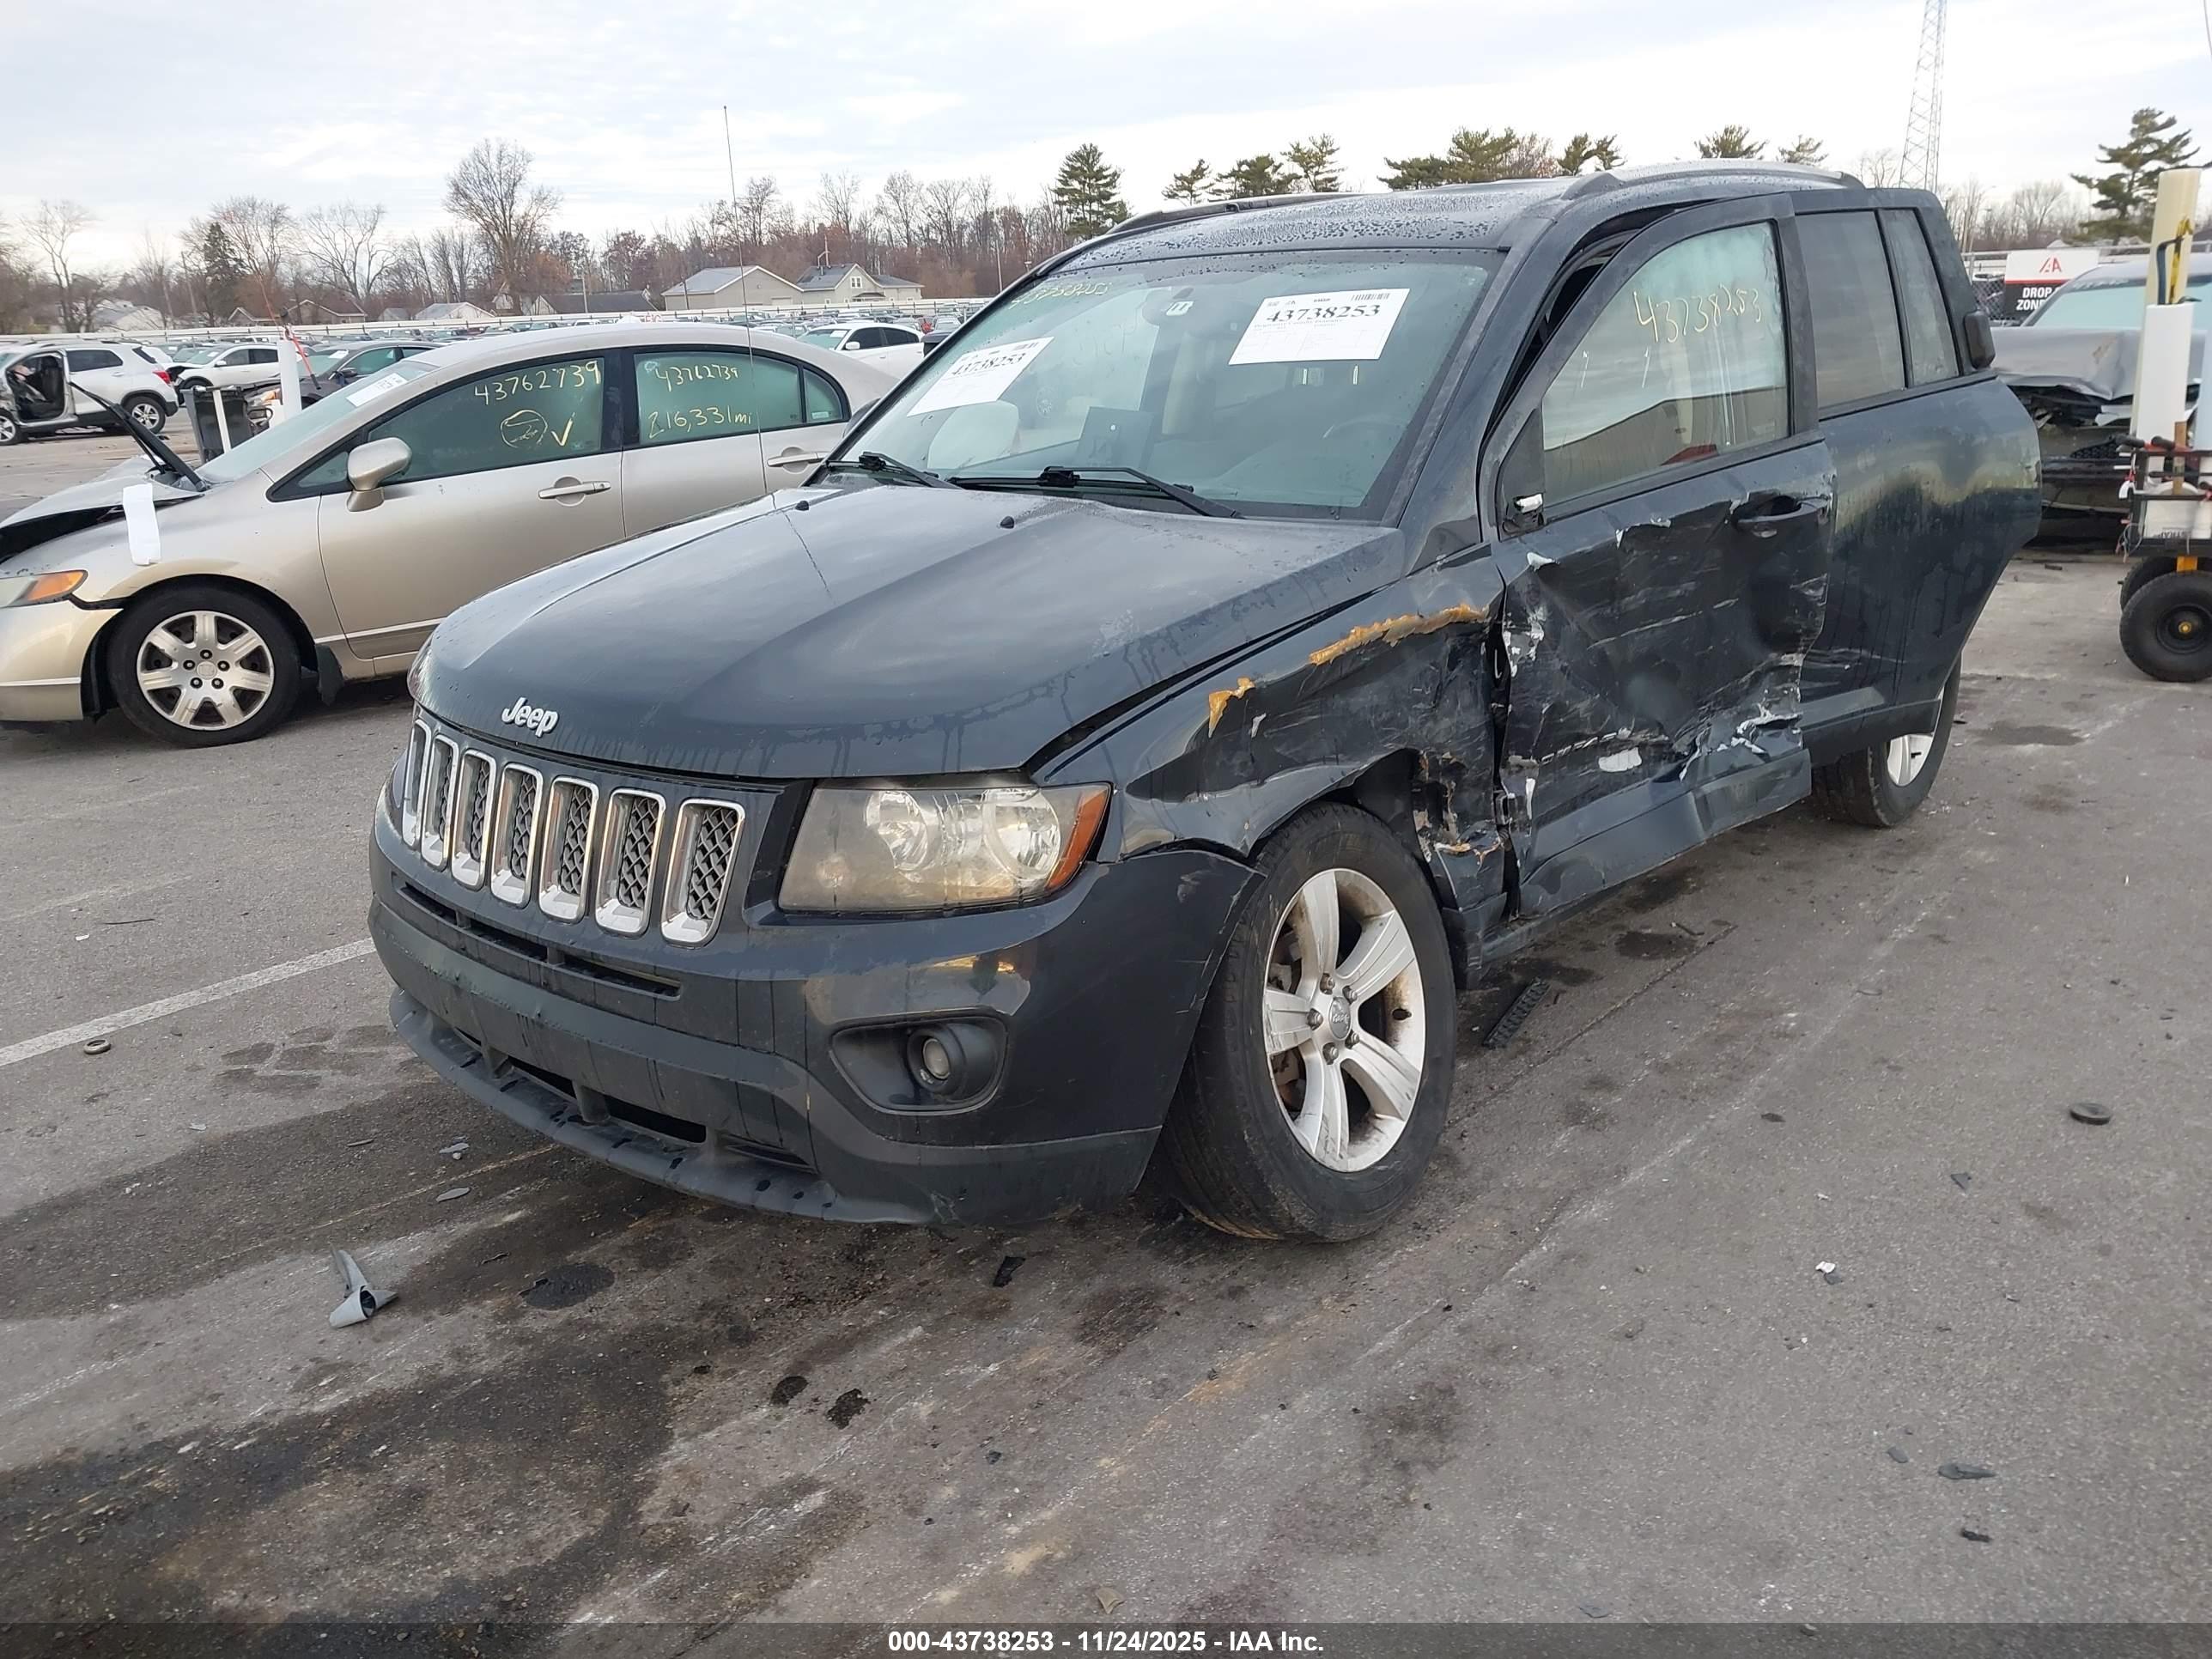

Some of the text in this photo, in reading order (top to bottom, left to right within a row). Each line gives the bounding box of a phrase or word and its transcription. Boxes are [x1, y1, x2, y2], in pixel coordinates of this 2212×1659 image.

[2022, 287, 2053, 298] DROP
[1267, 304, 1381, 323] 43738253
[475, 361, 600, 404] 43762739
[655, 364, 738, 392] 43762739
[501, 696, 558, 737] Jeep
